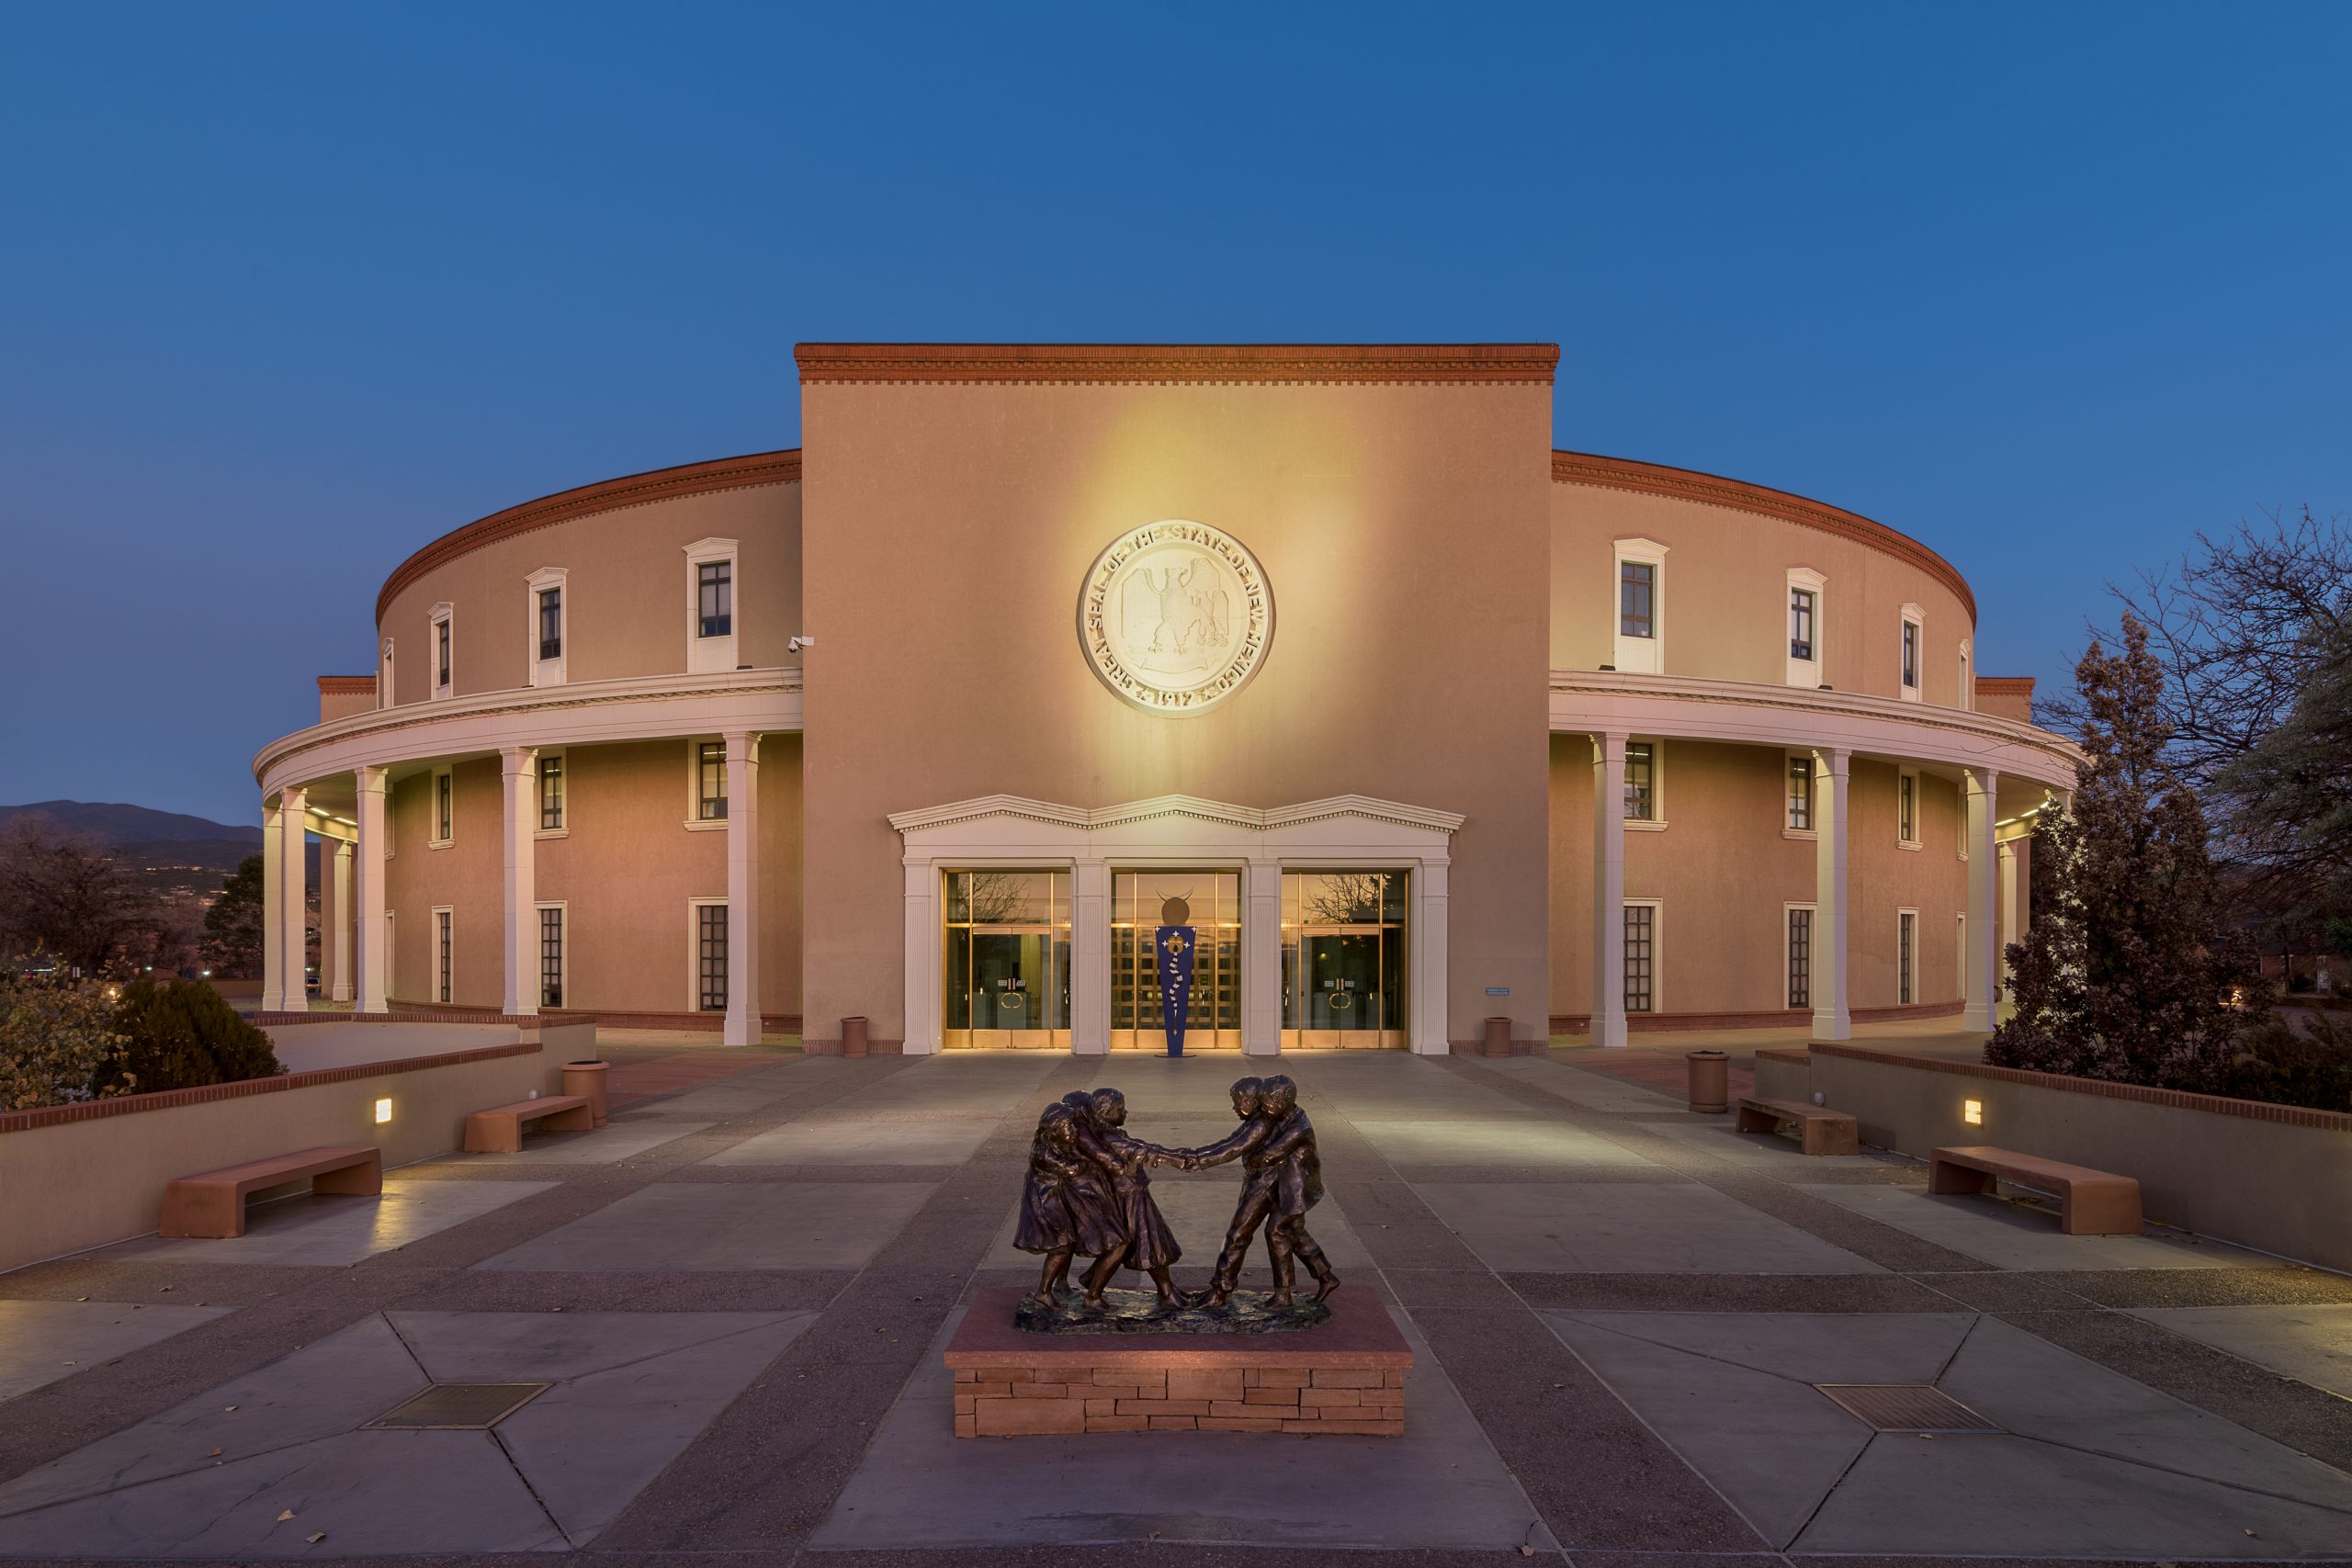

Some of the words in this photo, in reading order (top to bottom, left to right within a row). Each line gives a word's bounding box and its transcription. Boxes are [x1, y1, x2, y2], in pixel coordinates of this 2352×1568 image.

[1127, 526, 1161, 550] THE
[1171, 525, 1229, 554] STATE
[1104, 549, 1125, 572] OF
[1231, 553, 1251, 577] OF
[1088, 580, 1109, 631] SEAL
[1245, 581, 1264, 623] NEW
[1094, 637, 1133, 689] GREAT
[1216, 629, 1261, 691] MEXICO
[1158, 691, 1193, 706] 1912
